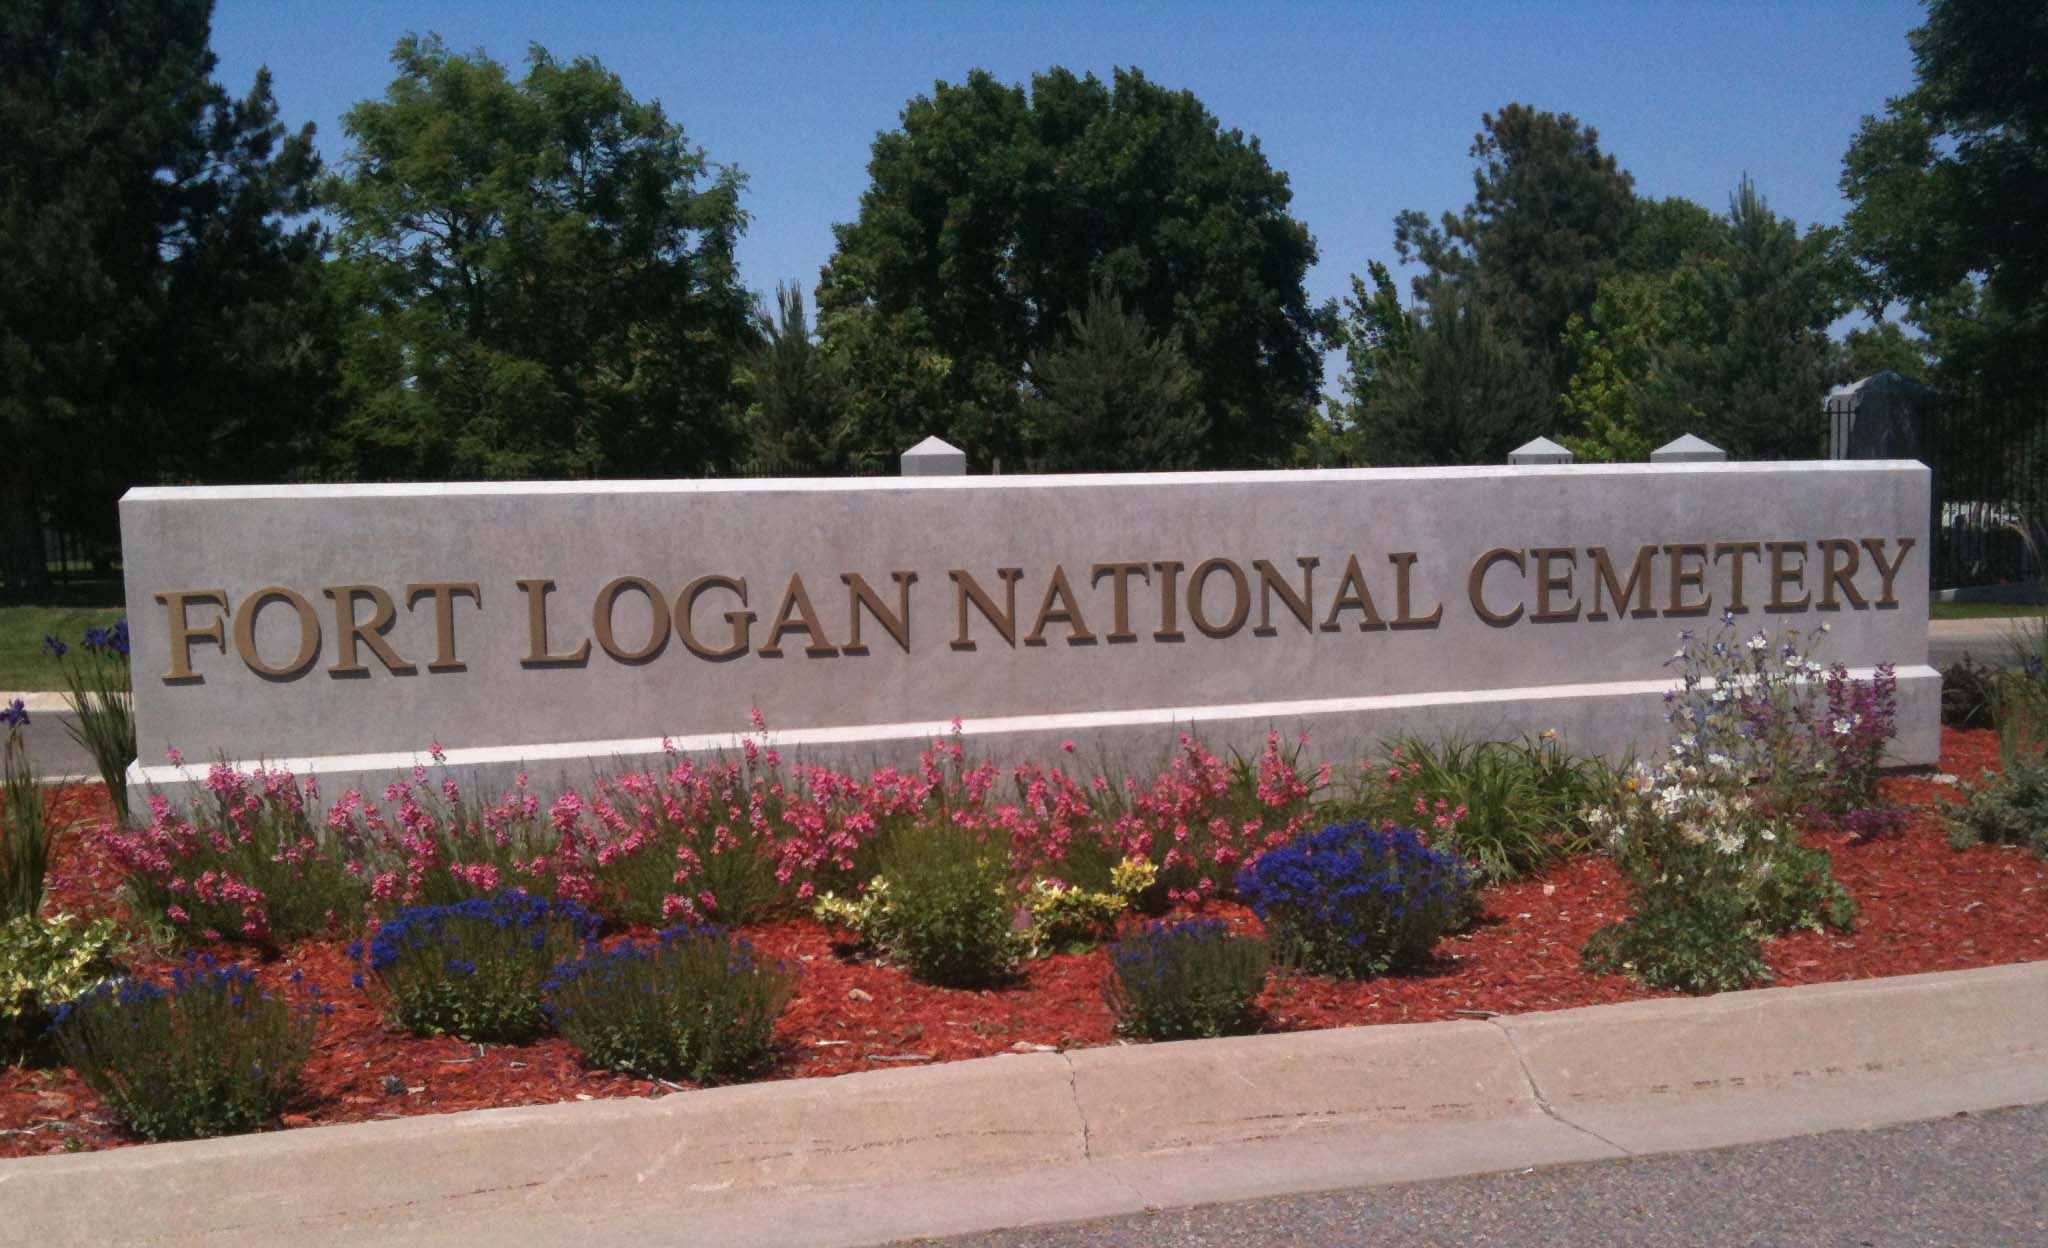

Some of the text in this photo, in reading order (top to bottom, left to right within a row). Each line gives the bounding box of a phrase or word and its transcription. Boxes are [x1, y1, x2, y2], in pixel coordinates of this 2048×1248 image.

[156, 538, 1916, 684] FORT LOGAN NATIONAL CEMETERY
